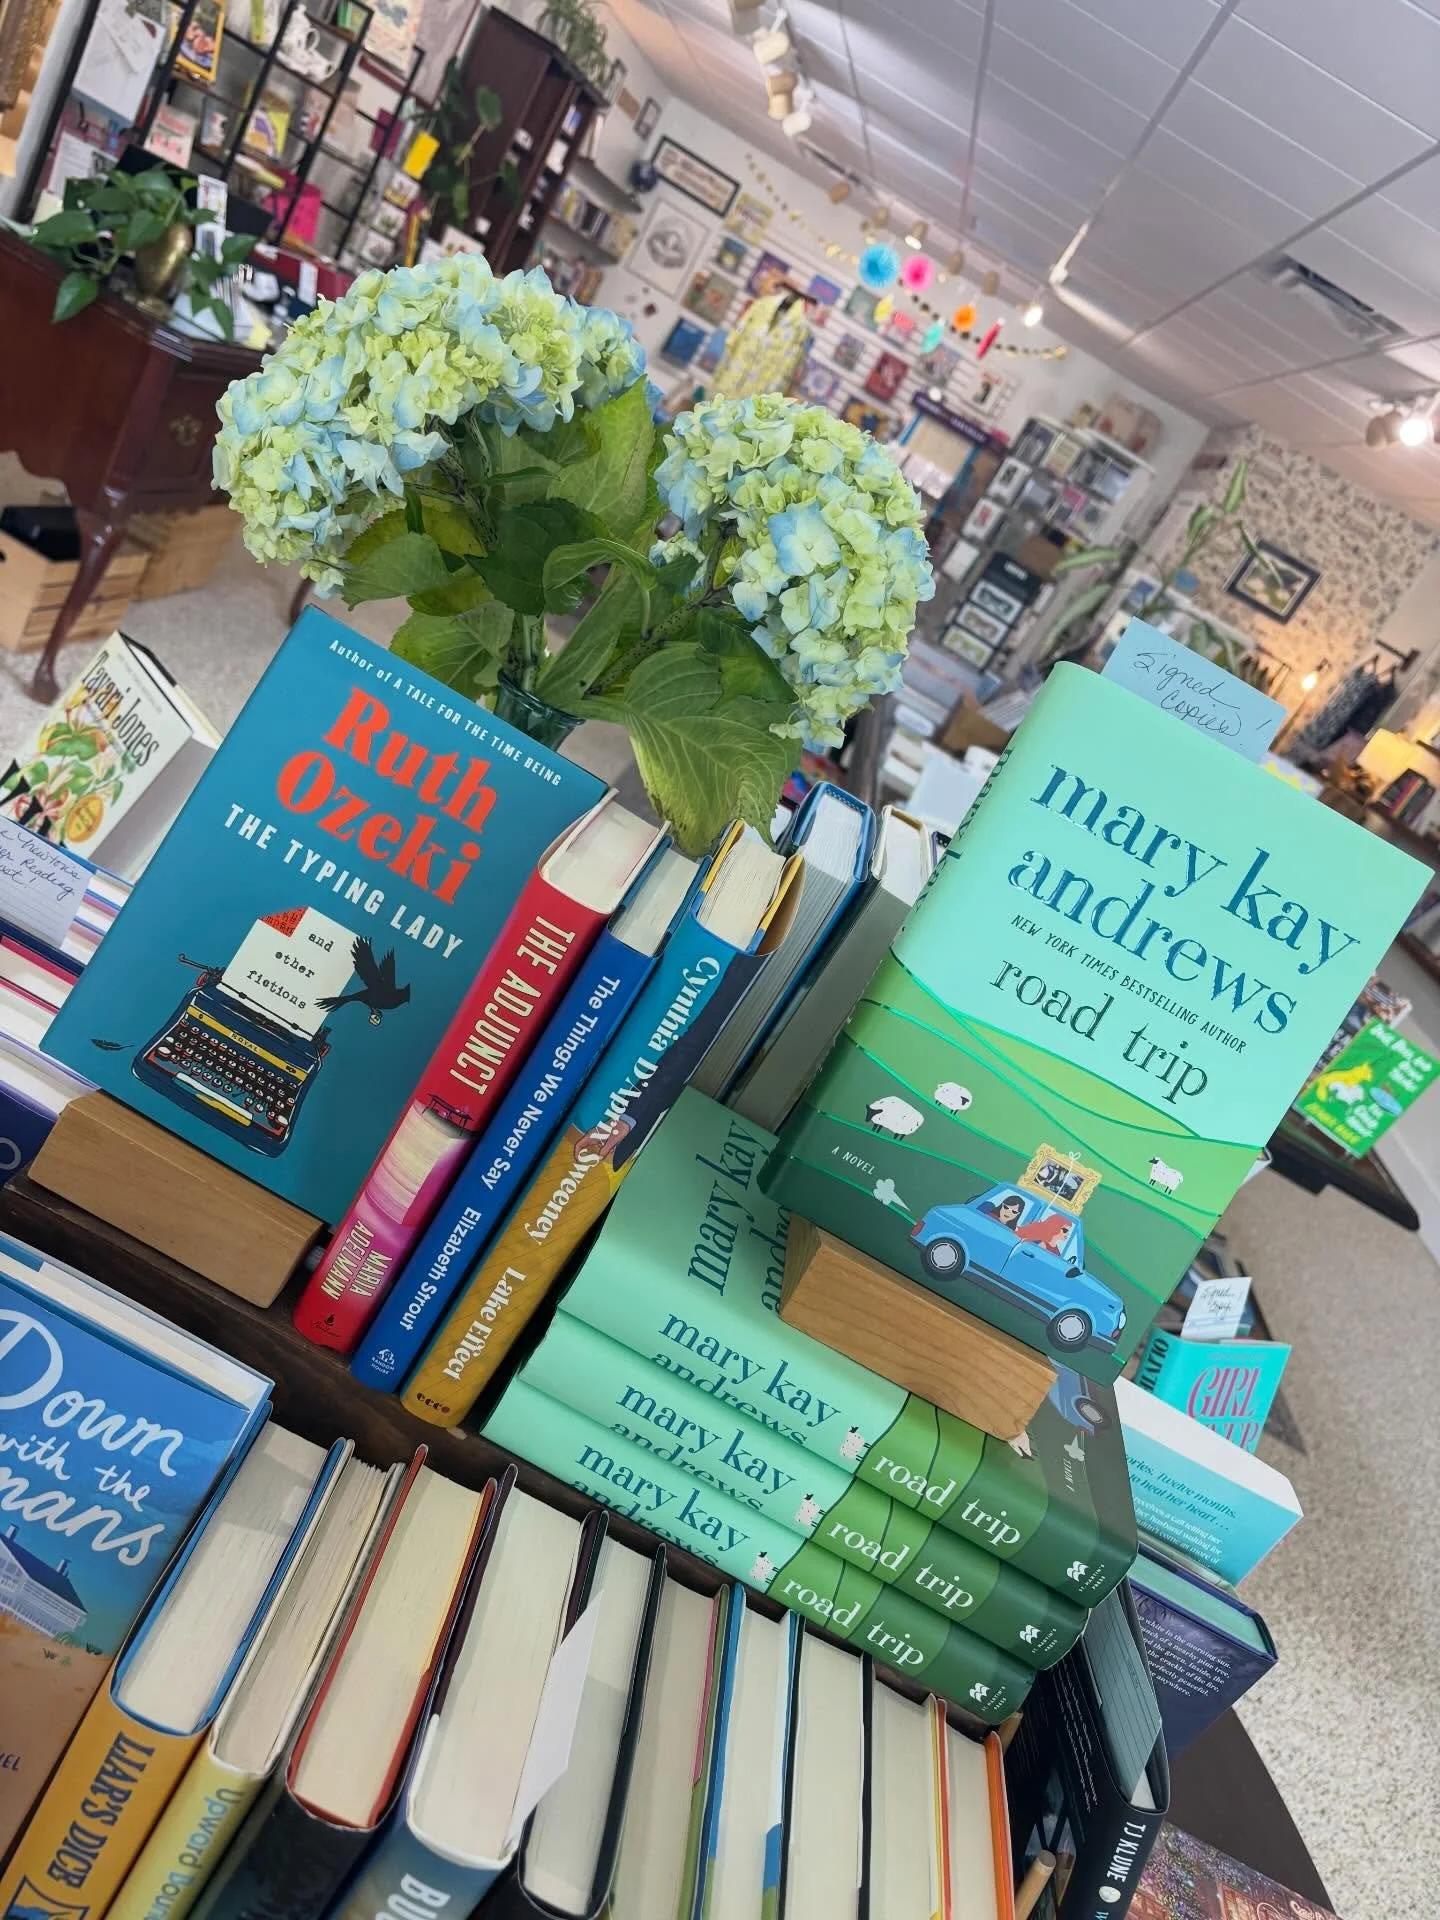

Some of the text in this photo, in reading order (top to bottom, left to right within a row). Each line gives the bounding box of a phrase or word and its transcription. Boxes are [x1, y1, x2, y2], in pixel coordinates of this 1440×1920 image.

[329, 639, 562, 787] Author of A TALE FOR THE TIME BEING
[1133, 652, 1241, 710] Signed
[112, 697, 160, 767] Jones
[322, 685, 497, 835] Ruth
[276, 750, 482, 906] Ozeki
[1030, 763, 1228, 898] mary
[1220, 847, 1361, 975] kay
[224, 803, 464, 959] THE TYPING LADY
[275, 950, 316, 980] other
[308, 932, 335, 953] and
[1007, 849, 1298, 1035] andrews
[1010, 914, 1248, 1054] NEW YORK TIMES BESTSELLING AUTHOR
[246, 968, 307, 1010] fictions
[449, 915, 576, 1096] THE ADJUNCT
[989, 959, 1209, 1105] road trip
[230, 1032, 259, 1053] ROYAL
[481, 975, 621, 1191] The Things We Never Say
[524, 956, 721, 1246] Cynthia D'Aprix Sweeney
[831, 1146, 875, 1175] A NOVEL
[687, 1120, 771, 1297] mary kay
[320, 1219, 375, 1301] ADELMANN
[350, 1249, 393, 1298] MARIA
[399, 1206, 482, 1331] Elizabeth Strout
[442, 1267, 528, 1381] Lake Effect
[657, 1312, 842, 1428] mary kay
[0, 1307, 184, 1477] Down
[416, 1391, 450, 1414] ecco
[650, 1353, 808, 1445] andrews
[1187, 1367, 1263, 1420] GIRL
[609, 1423, 765, 1511] andrews
[615, 1384, 797, 1495] mary kay
[94, 1464, 151, 1513] the
[575, 1444, 751, 1552] mary kay
[871, 1455, 1021, 1547] road trip
[1140, 1478, 1167, 1501] heal
[1165, 1490, 1187, 1507] her
[826, 1522, 974, 1609] road trip
[780, 1578, 924, 1667] road trip
[46, 1731, 157, 1889] LIAR'S DICE
[178, 1788, 245, 1869] Upward
[1106, 1821, 1147, 1883] TJ KLUNE
